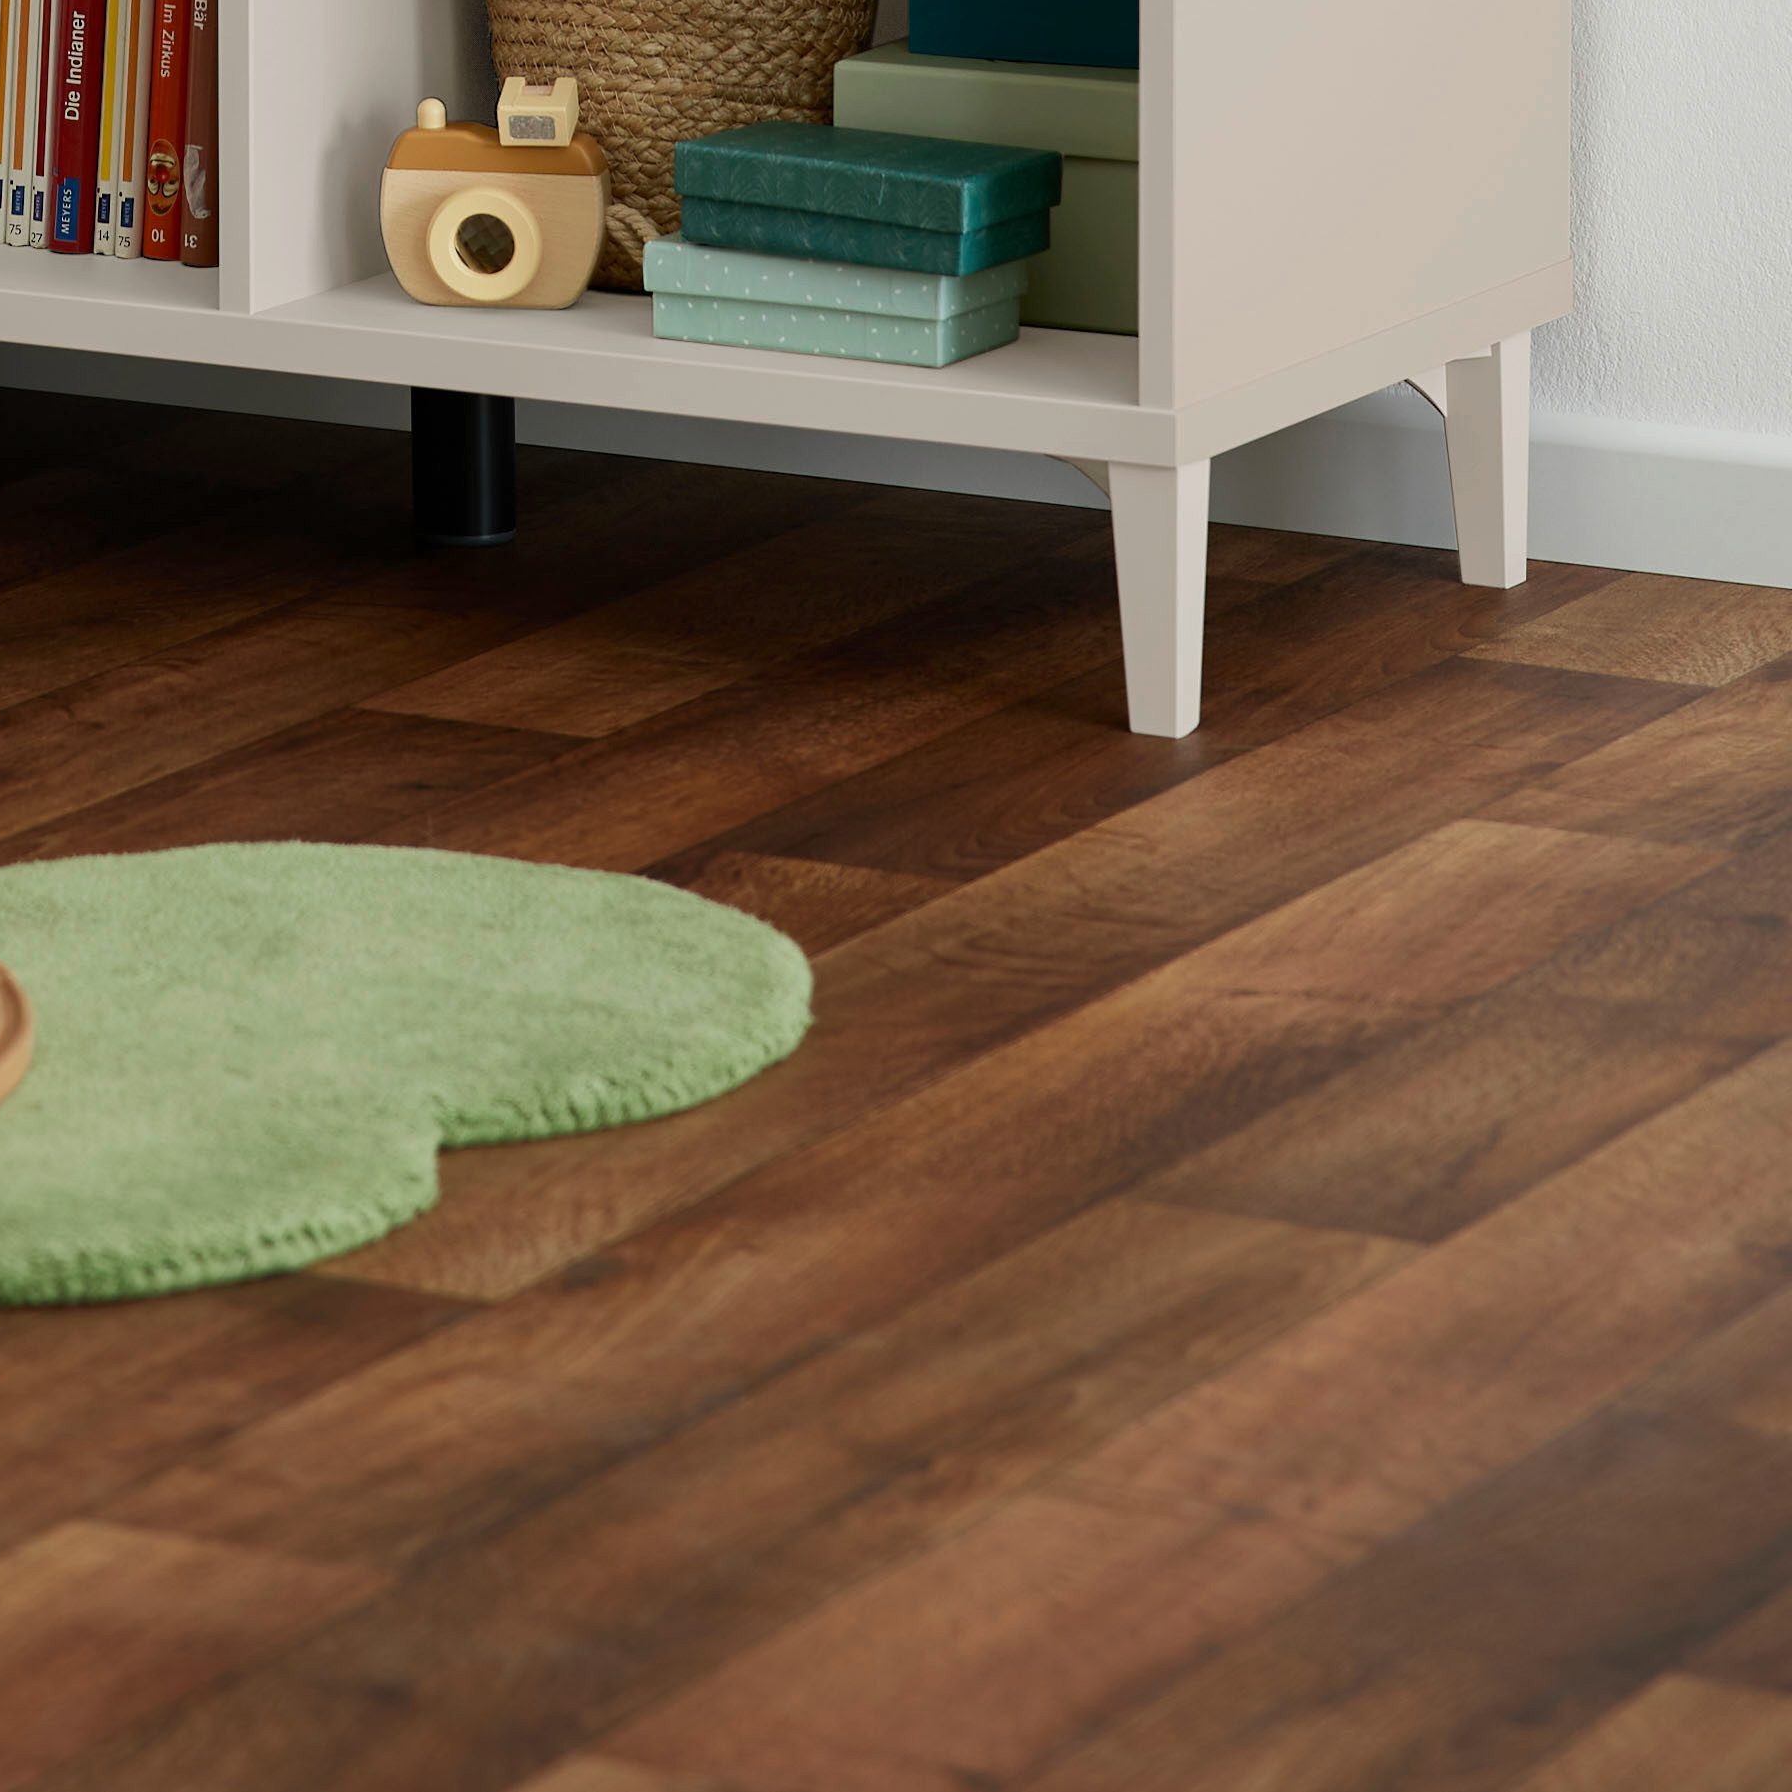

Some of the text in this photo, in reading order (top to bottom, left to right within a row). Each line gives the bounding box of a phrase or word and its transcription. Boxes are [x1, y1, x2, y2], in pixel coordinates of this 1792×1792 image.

[160, 3, 177, 78] Im Zirkus
[64, 11, 86, 121] Die Indianer
[61, 188, 73, 235] MEYERS
[9, 224, 22, 236] 75
[97, 230, 109, 242] 14
[151, 228, 165, 243] 10
[31, 232, 43, 244] 27
[118, 236, 131, 248] 75
[184, 233, 197, 248] 31
